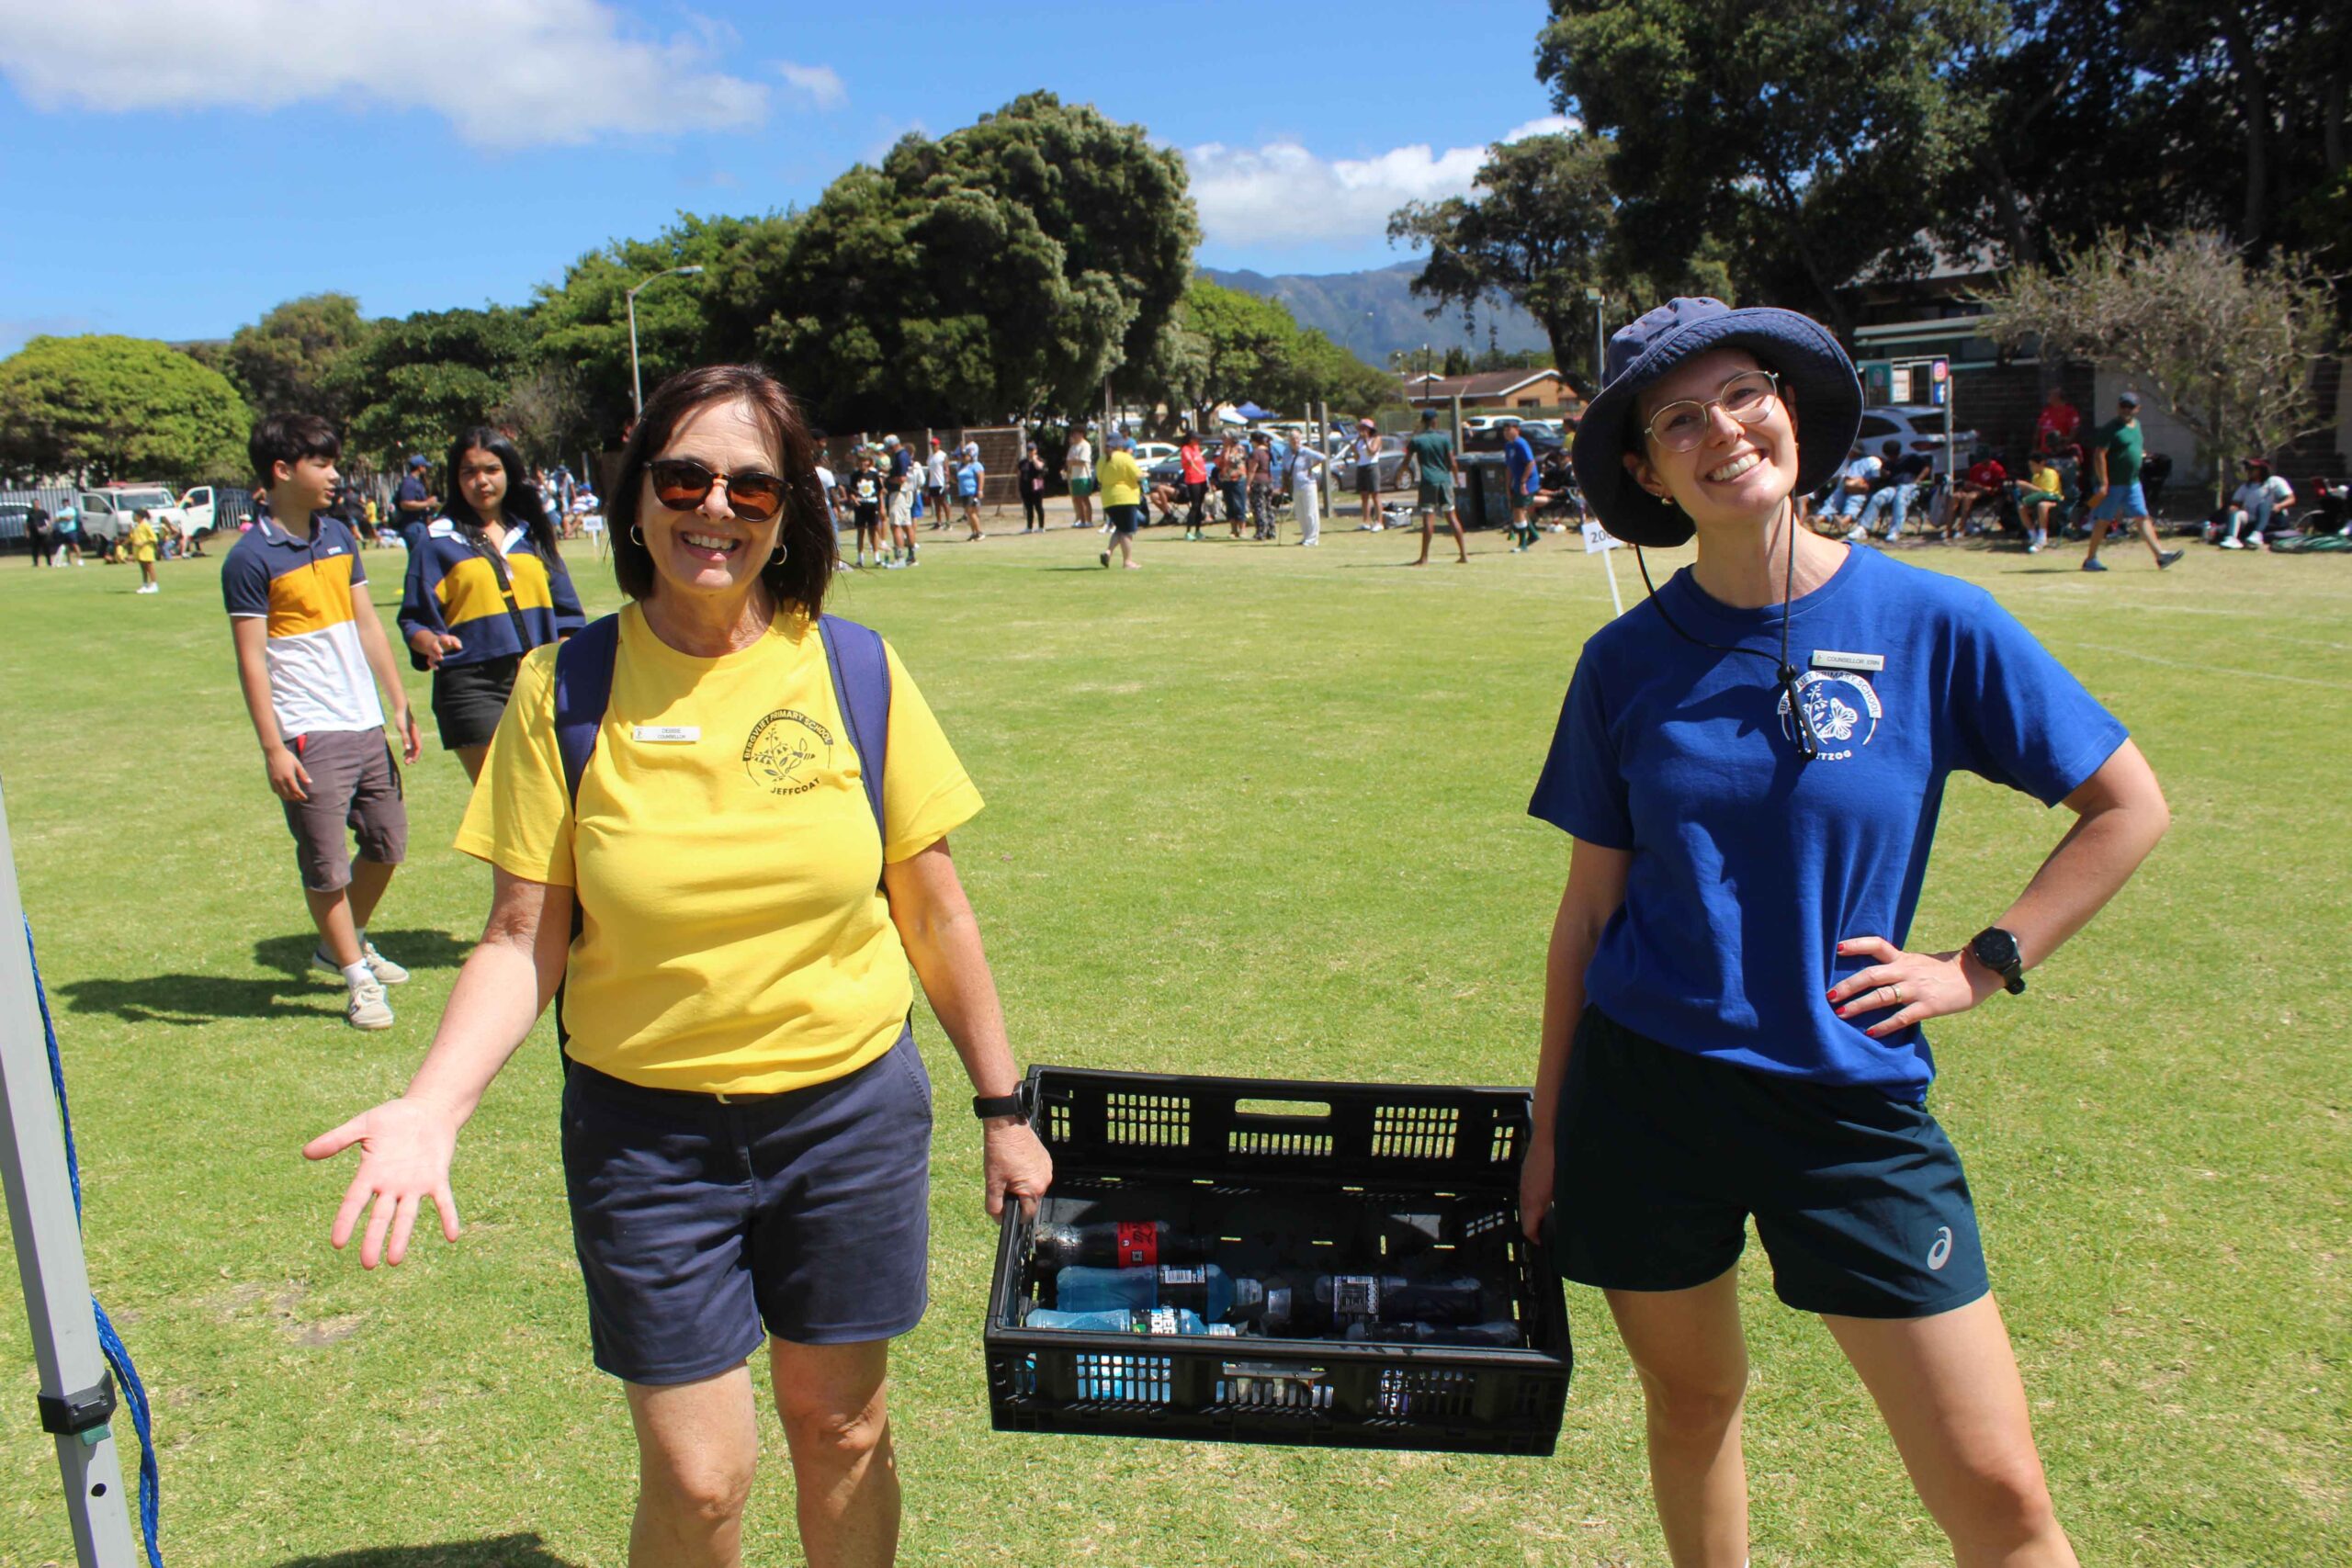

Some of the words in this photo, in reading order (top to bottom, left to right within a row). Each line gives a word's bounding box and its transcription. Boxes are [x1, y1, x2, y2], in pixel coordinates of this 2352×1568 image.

[1815, 671, 1857, 682] PRIMARY
[1856, 680, 1880, 715] SCHOOL
[744, 717, 770, 759] BERGVLIET
[770, 710, 805, 722] PRIMARY
[804, 718, 831, 743] SCHOOL
[1815, 750, 1852, 761] TZOG
[770, 777, 820, 795] JEFFCOAT
